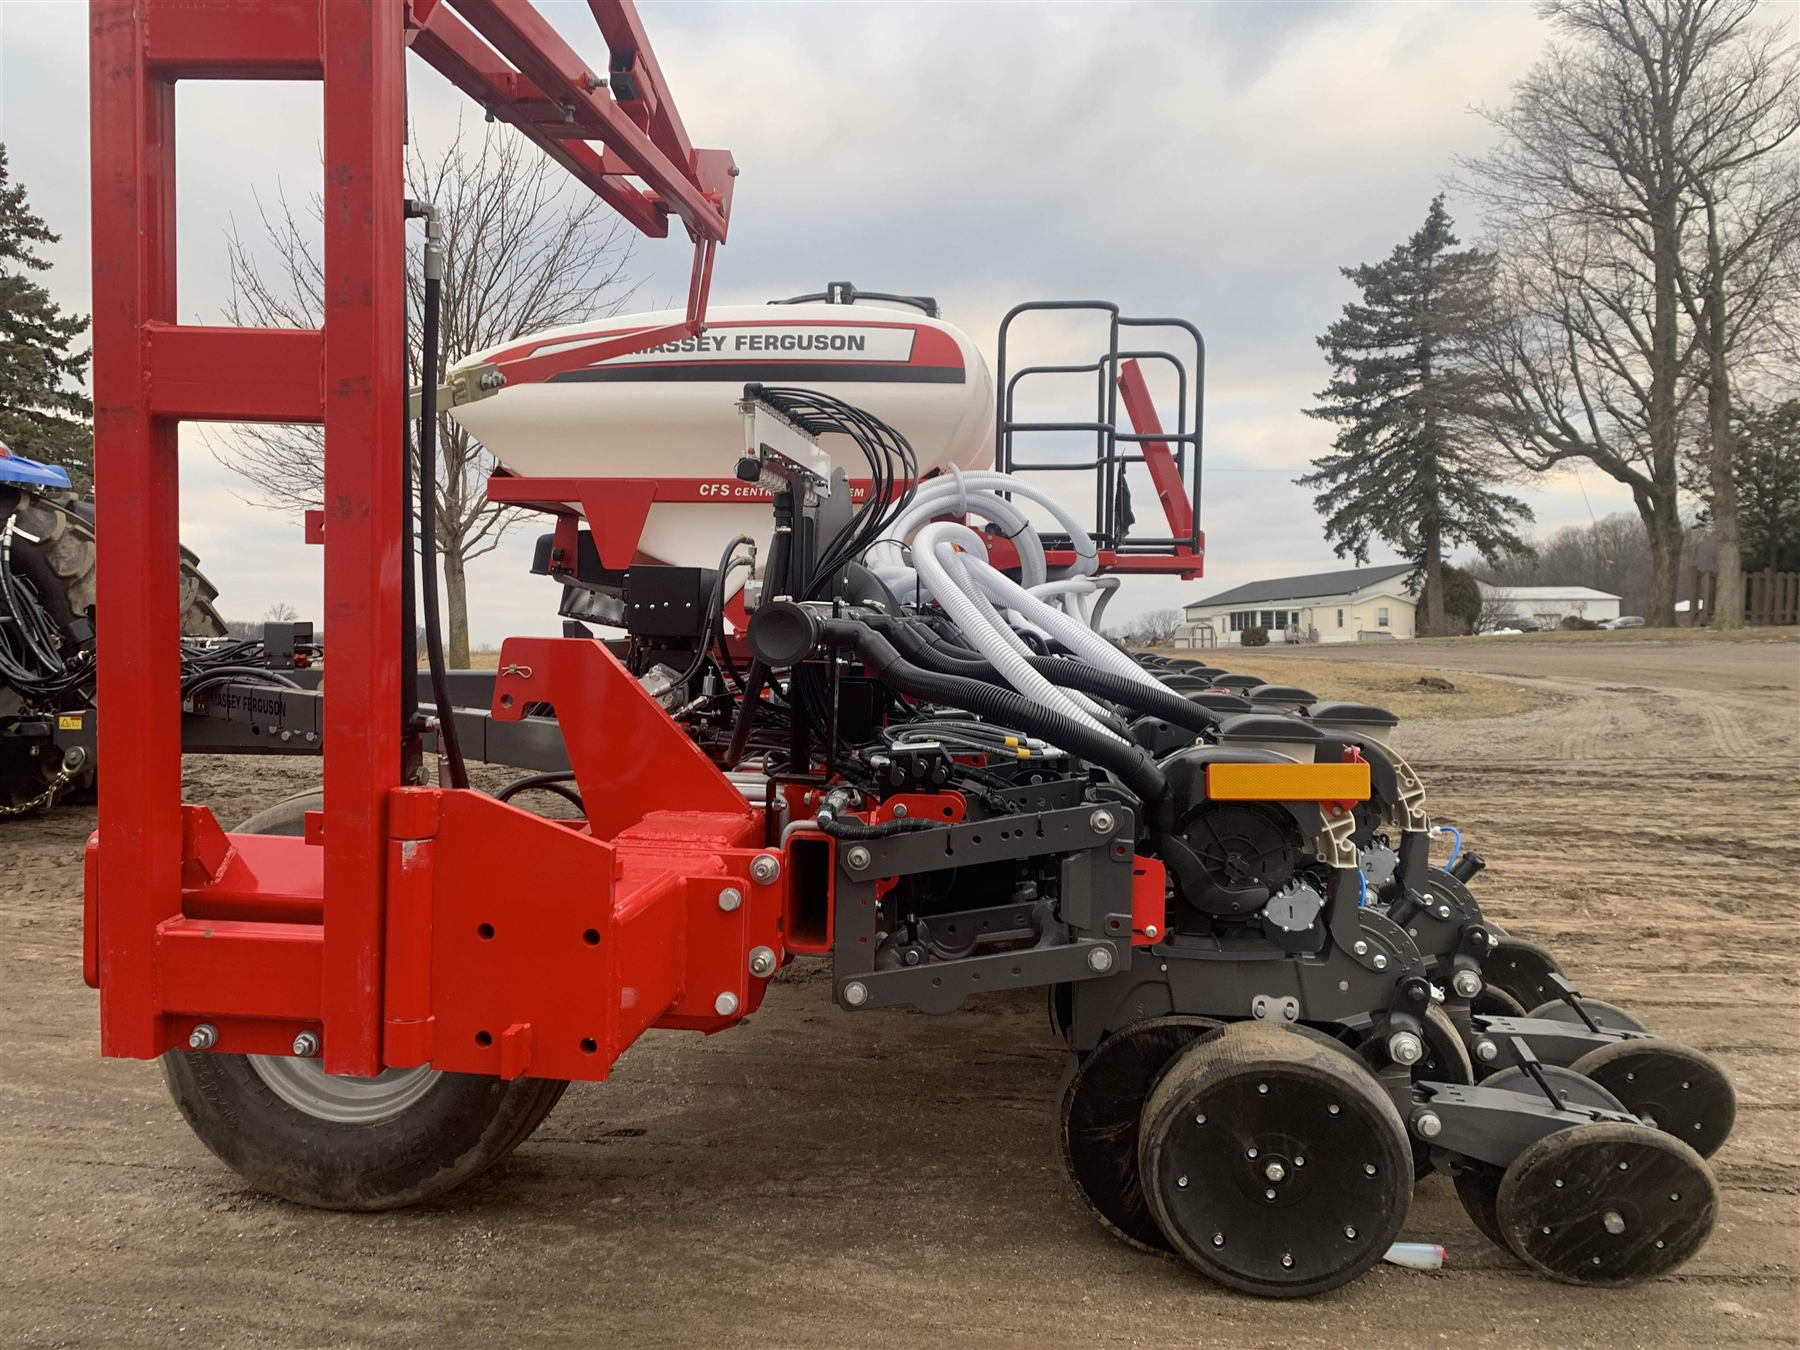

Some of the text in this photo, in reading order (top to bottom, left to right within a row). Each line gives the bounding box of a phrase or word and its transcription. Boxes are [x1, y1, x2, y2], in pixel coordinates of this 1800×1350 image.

[632, 334, 865, 354] ASSEY FERGUSON
[699, 484, 775, 497] CFS CENTR
[1366, 862, 1375, 873] 2
